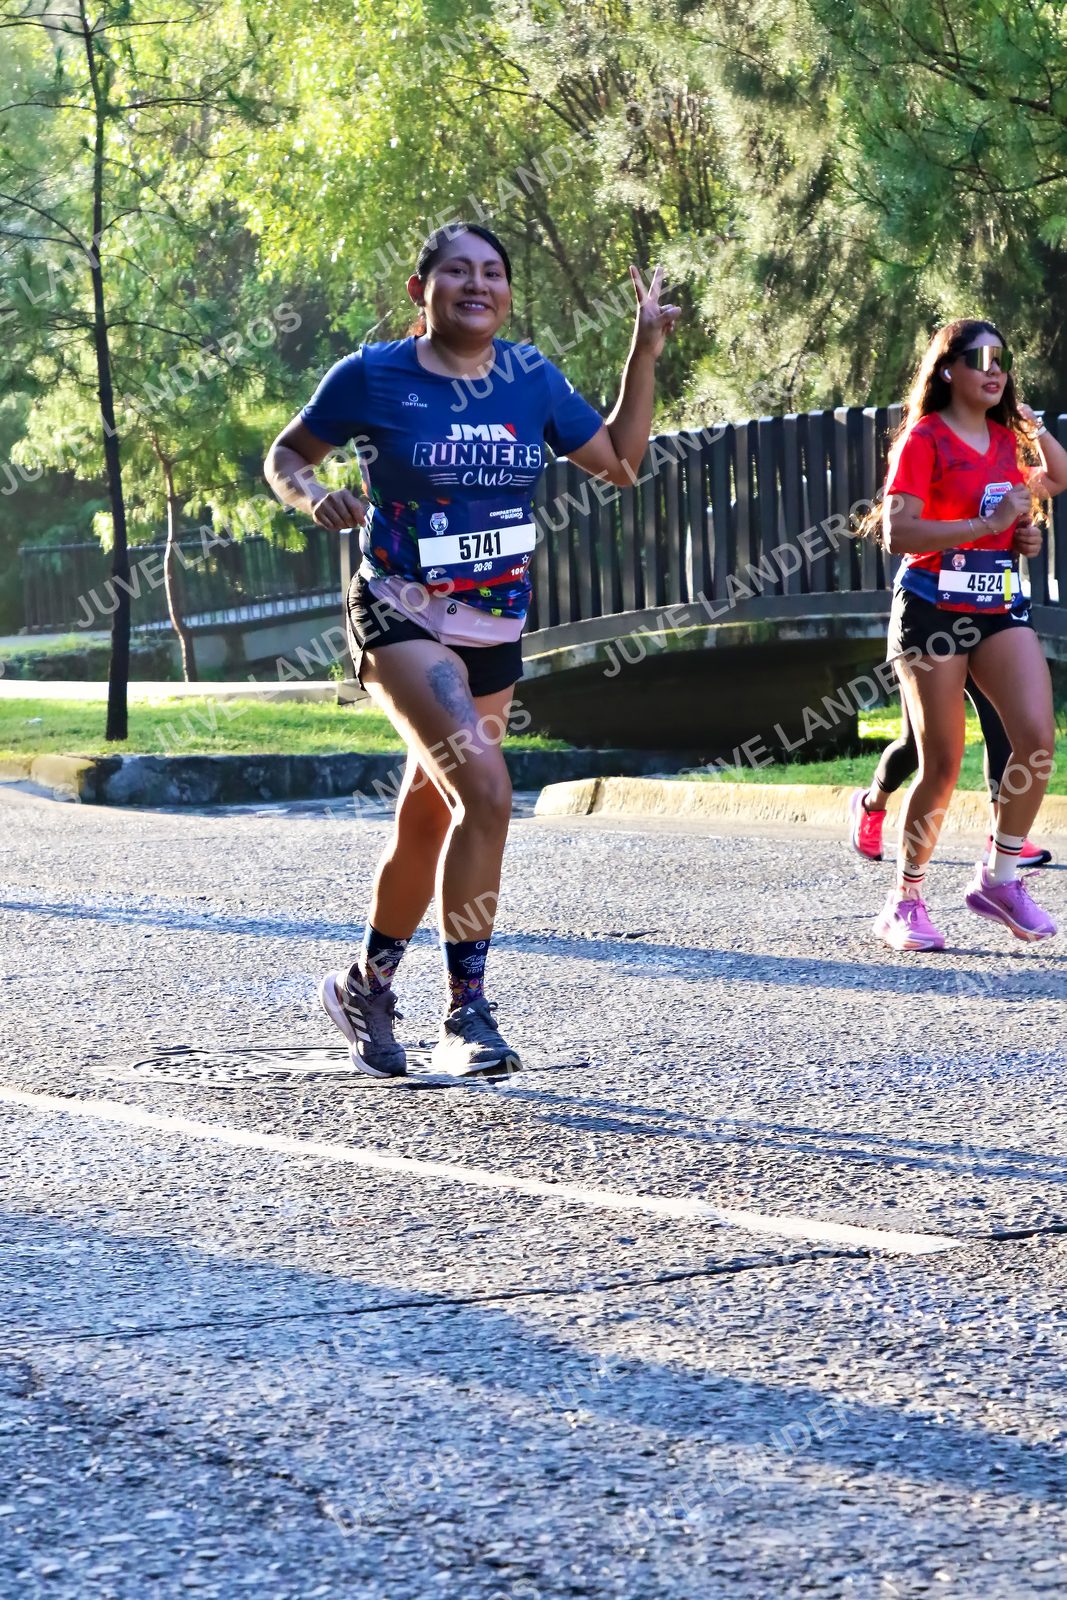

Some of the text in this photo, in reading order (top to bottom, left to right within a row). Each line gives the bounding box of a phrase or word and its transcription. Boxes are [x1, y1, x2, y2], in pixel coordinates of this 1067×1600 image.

[445, 423, 518, 442] JMA
[412, 441, 542, 469] RUNNERS
[462, 467, 513, 487] club
[458, 531, 501, 560] 5741
[511, 566, 525, 576] 10K
[967, 574, 1003, 592] 4524
